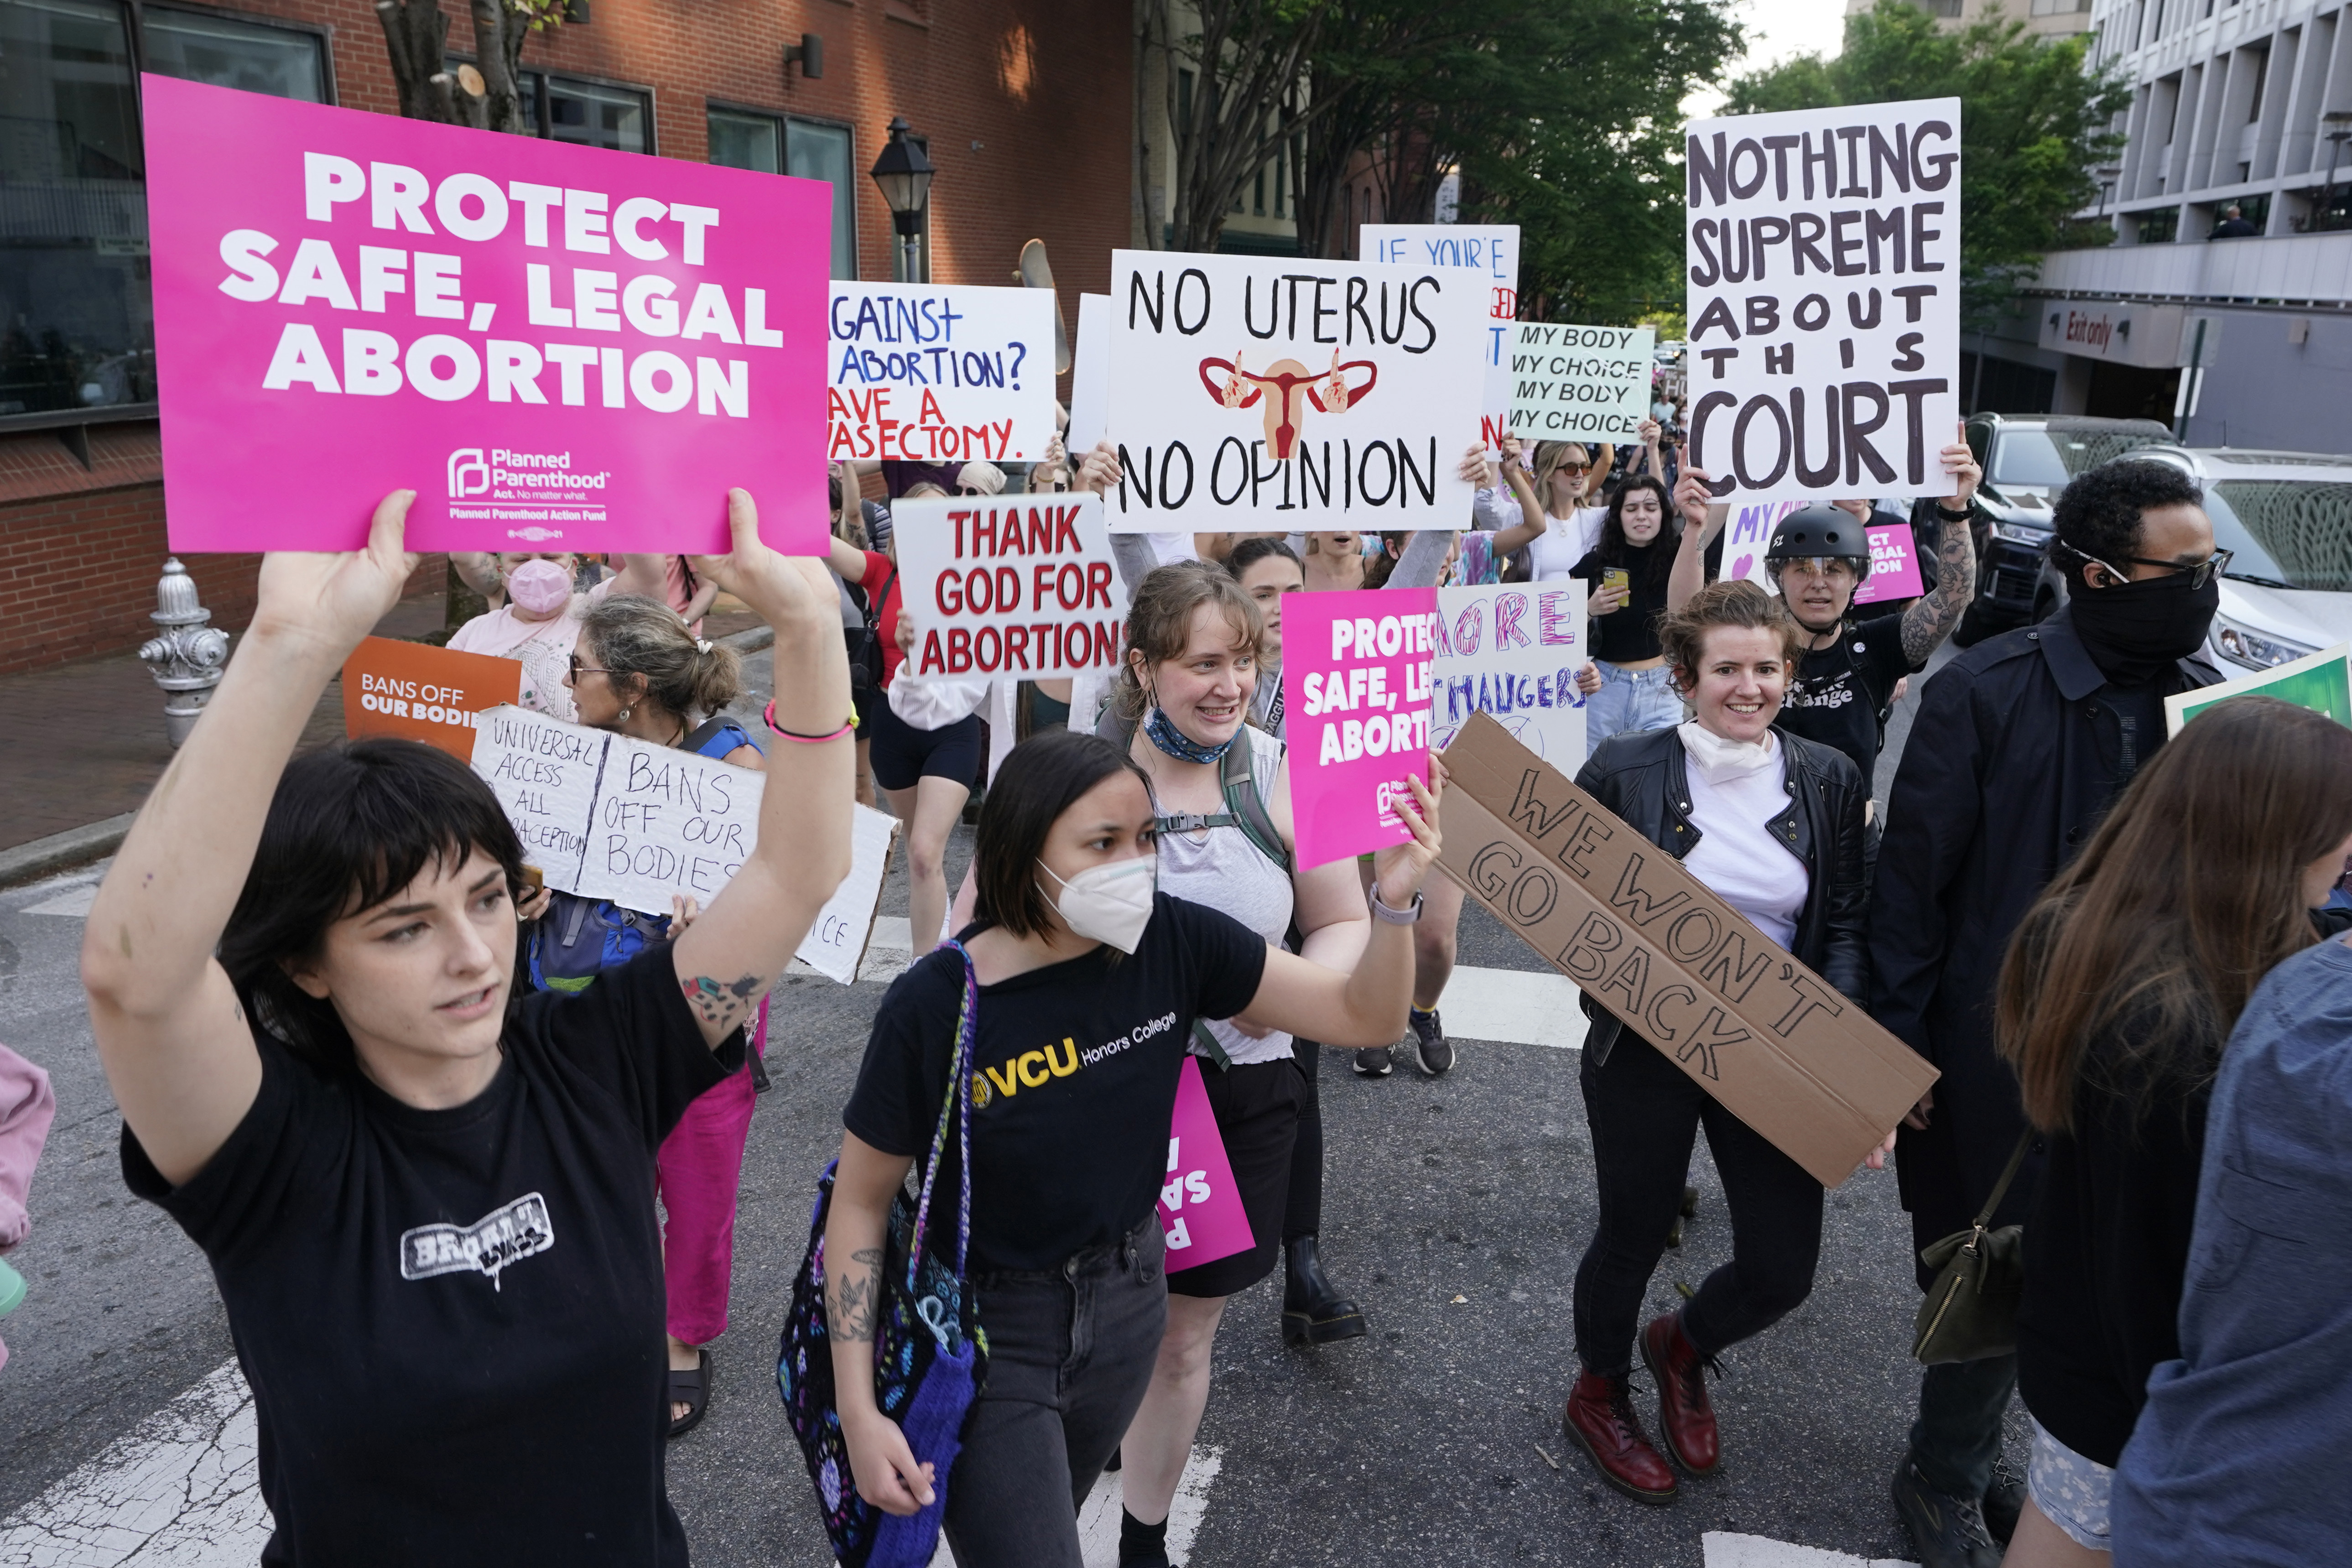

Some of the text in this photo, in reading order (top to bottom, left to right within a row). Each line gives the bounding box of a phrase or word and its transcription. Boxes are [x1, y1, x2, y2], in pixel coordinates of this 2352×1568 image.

[1688, 120, 1959, 208] NOTHING
[304, 151, 719, 266] PROTECT
[1690, 201, 1945, 287] SUPREME
[218, 229, 783, 348] SAFE, LEGAL
[1129, 268, 1441, 354] NO UTERUS
[828, 297, 963, 344] GAINST
[1690, 285, 1937, 342] ABOUT
[2066, 311, 2113, 354] Exit only
[1520, 326, 1634, 350] MY BODY
[1701, 332, 1925, 379] THIS
[262, 323, 749, 418] ABORTION
[838, 342, 1026, 391] ABORTION?
[1549, 356, 1642, 380] CHOICE
[920, 388, 945, 424] A
[1516, 381, 1629, 404] MY BODY
[1546, 411, 1639, 433] CHOICE
[1689, 378, 1948, 497] COURT
[492, 449, 570, 469] Planned
[493, 469, 605, 489] Parenthood
[1119, 436, 1436, 512] NO OPINION
[449, 508, 606, 521] Planned Parenthood Action Fund
[494, 489, 588, 500] Act. No matter what.
[947, 504, 1082, 559] THANK
[1732, 502, 1775, 544] MY
[1869, 545, 1907, 560] GAL
[935, 562, 1113, 616] GOD FOR
[919, 619, 1129, 676] ABORTION
[361, 693, 408, 718] OUR
[362, 673, 464, 705] BANS OFF
[1303, 666, 1398, 716] SAFE,
[495, 718, 593, 766] UNIVERSAL
[494, 753, 563, 787] ACCESS
[625, 753, 732, 814] BANS
[515, 790, 550, 815] ALL
[605, 797, 744, 857] OFF OUR
[1508, 768, 1843, 1037] WE WON'T
[1468, 841, 1752, 1080] GO BACK
[985, 1037, 1079, 1097] VCU
[1081, 1036, 1130, 1067] Honors
[1132, 1011, 1176, 1043] College
